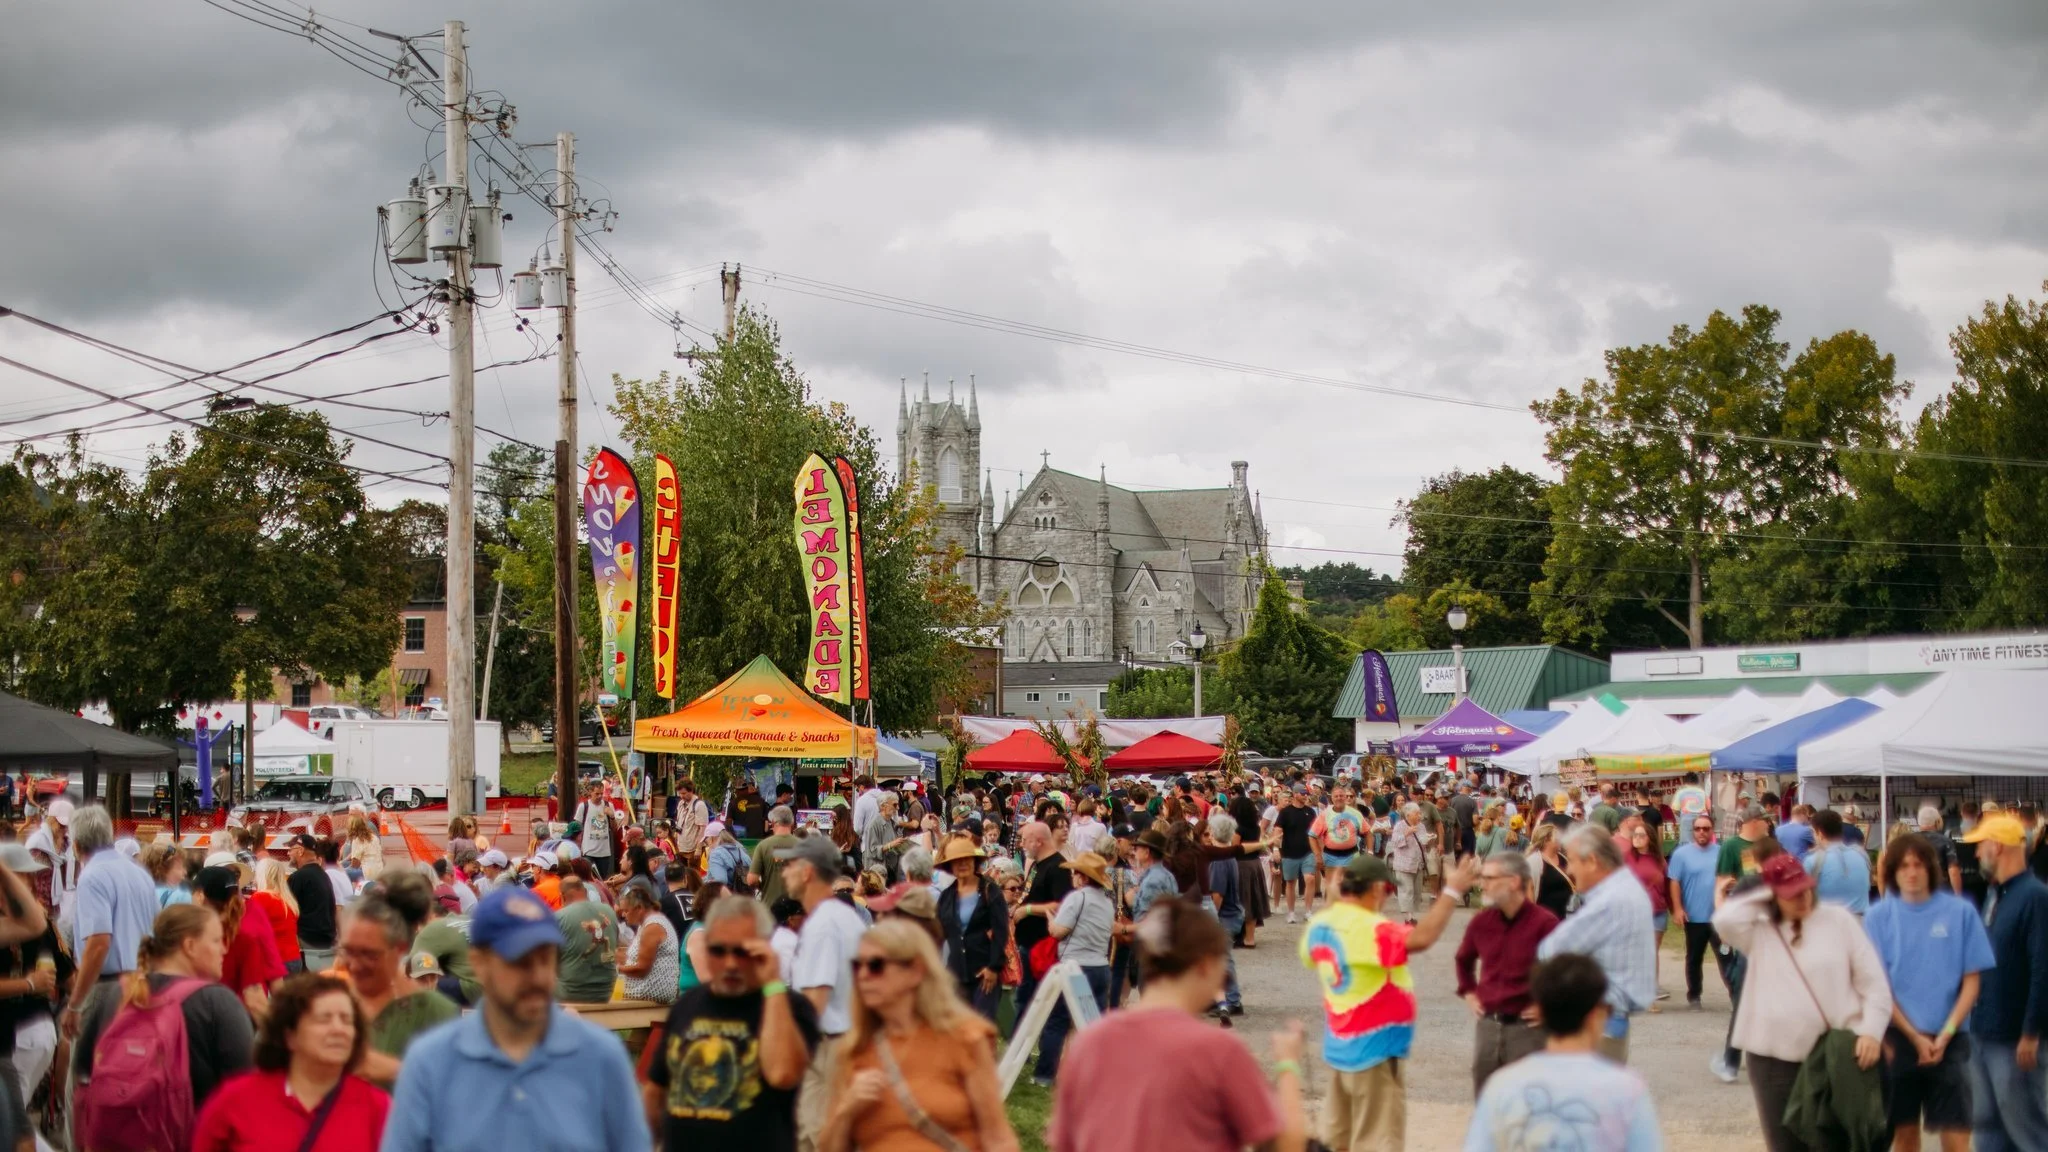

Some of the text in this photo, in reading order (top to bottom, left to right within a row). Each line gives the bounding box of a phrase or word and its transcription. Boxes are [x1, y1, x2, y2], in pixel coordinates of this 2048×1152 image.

[1932, 644, 2048, 662] ANYTIME FITNESS
[651, 725, 840, 743] Fresh Squeezed Lemonade & Snacks
[1432, 726, 1494, 735] Holmquest
[683, 742, 700, 750] Giving
